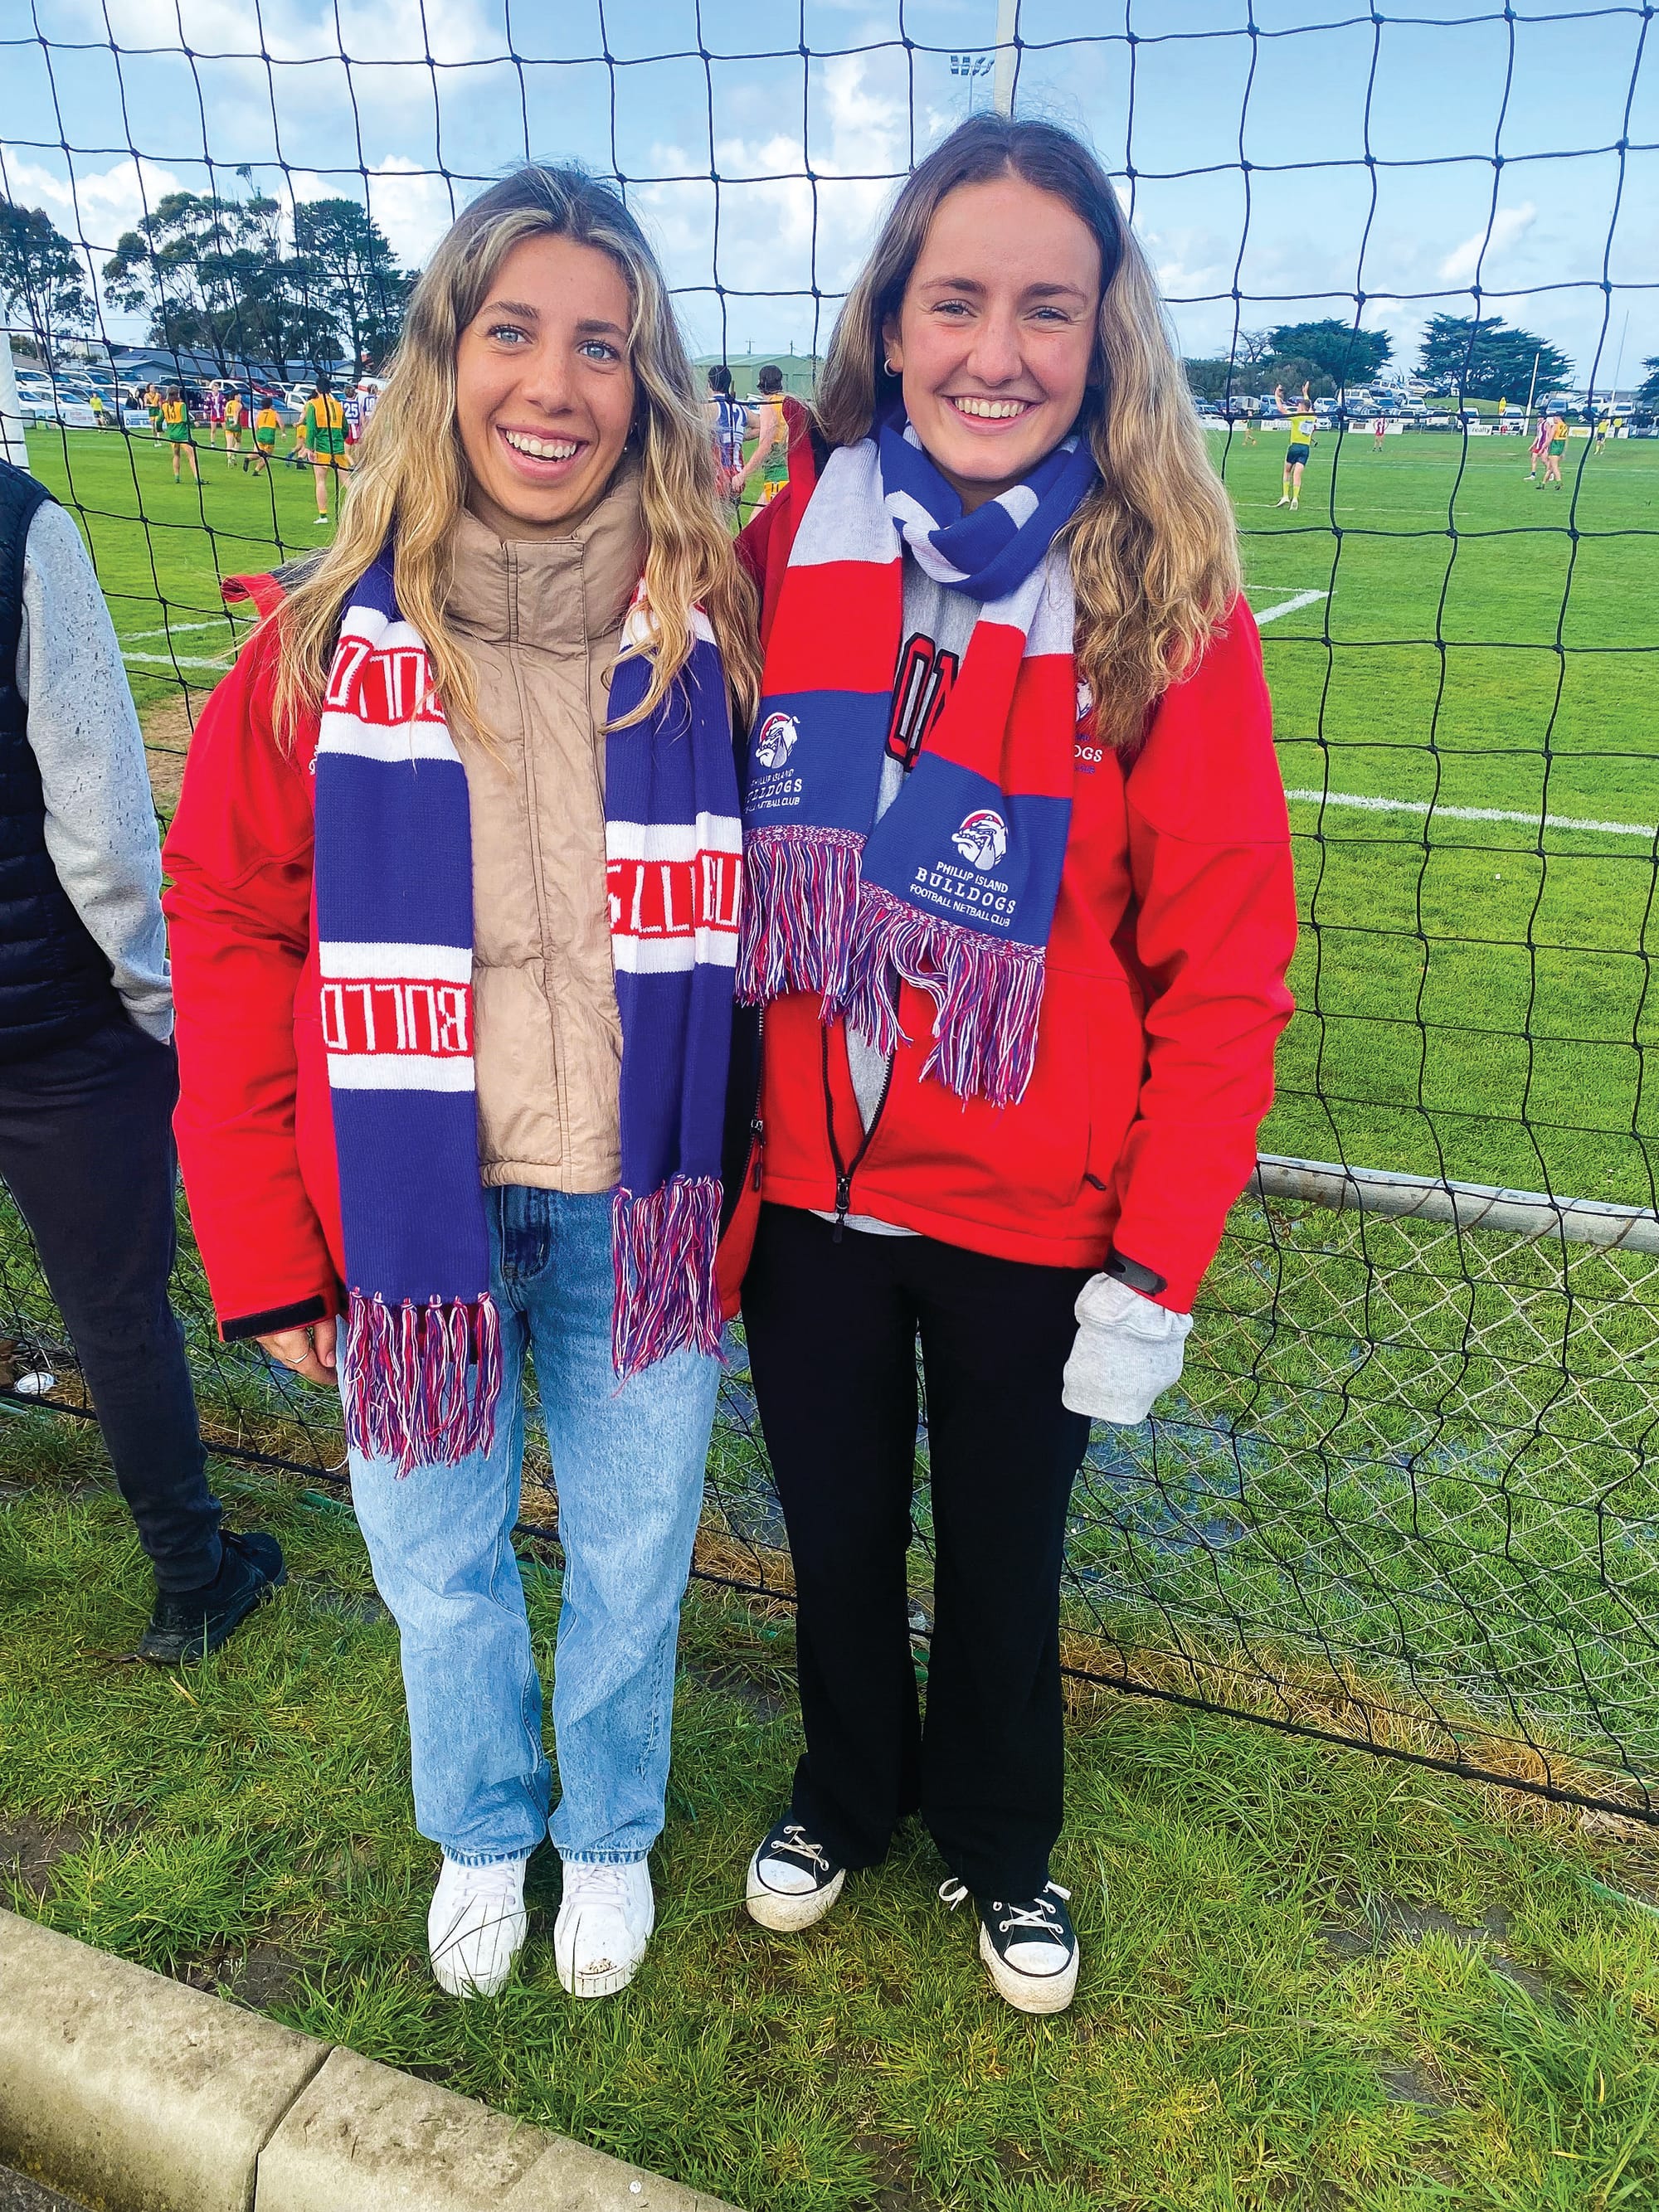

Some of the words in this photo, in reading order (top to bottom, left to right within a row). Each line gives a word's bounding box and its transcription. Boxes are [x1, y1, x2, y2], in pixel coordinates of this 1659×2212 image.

[263, 411, 269, 424] 7
[344, 402, 358, 418] 25
[781, 796, 800, 806] CLUB
[936, 861, 974, 881] PHILLIP
[975, 874, 1009, 893] ISLAND
[915, 867, 1016, 914] BULLDOGS
[909, 883, 952, 908] FOOTBALL
[952, 901, 990, 921] NETBALL
[990, 914, 1011, 927] CLUB
